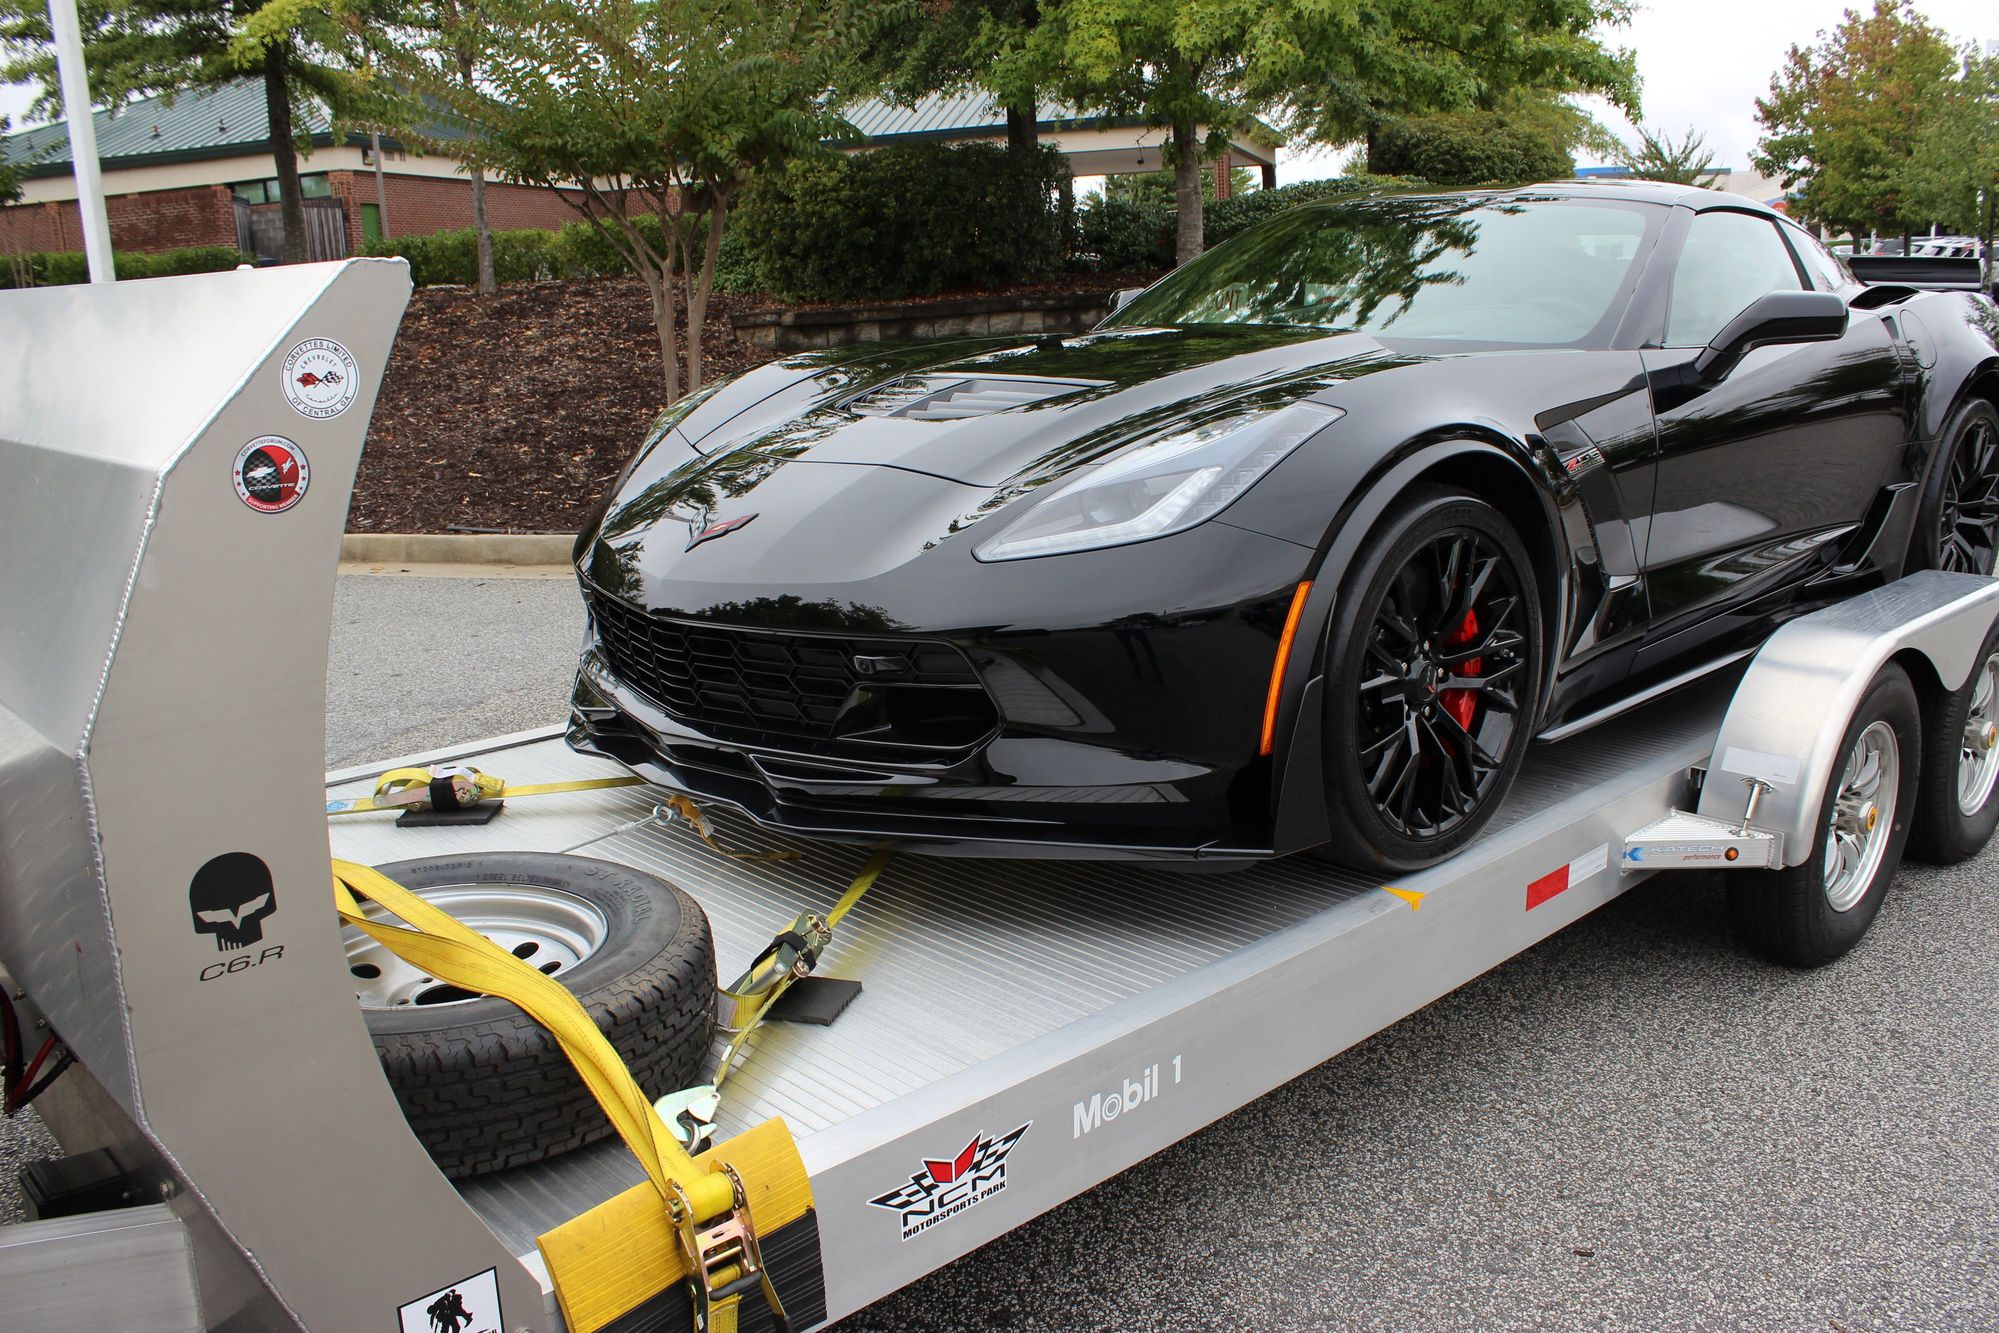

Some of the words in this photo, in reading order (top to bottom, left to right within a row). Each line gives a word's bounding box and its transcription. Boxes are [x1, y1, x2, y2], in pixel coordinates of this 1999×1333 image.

[285, 340, 324, 371] CORVETTES
[326, 342, 353, 368] LIMITED
[300, 354, 338, 369] CHEVROLET
[292, 397, 303, 407] OF
[303, 406, 341, 416] CENTRAL
[241, 438, 295, 457] CORVETTEFORUM.COM
[248, 482, 295, 491] CORVETTE
[247, 497, 279, 510] SUPPORTING
[279, 493, 297, 508] MEMBER
[1650, 845, 1724, 853] KATECH
[1683, 853, 1721, 861] performance
[199, 945, 285, 982] C6.R
[1073, 1063, 1159, 1139] Mobil
[1172, 1054, 1182, 1084] 1
[902, 1162, 1005, 1228] NCM
[903, 1194, 979, 1240] MOTORSPORTS
[980, 1180, 1006, 1200] PARK
